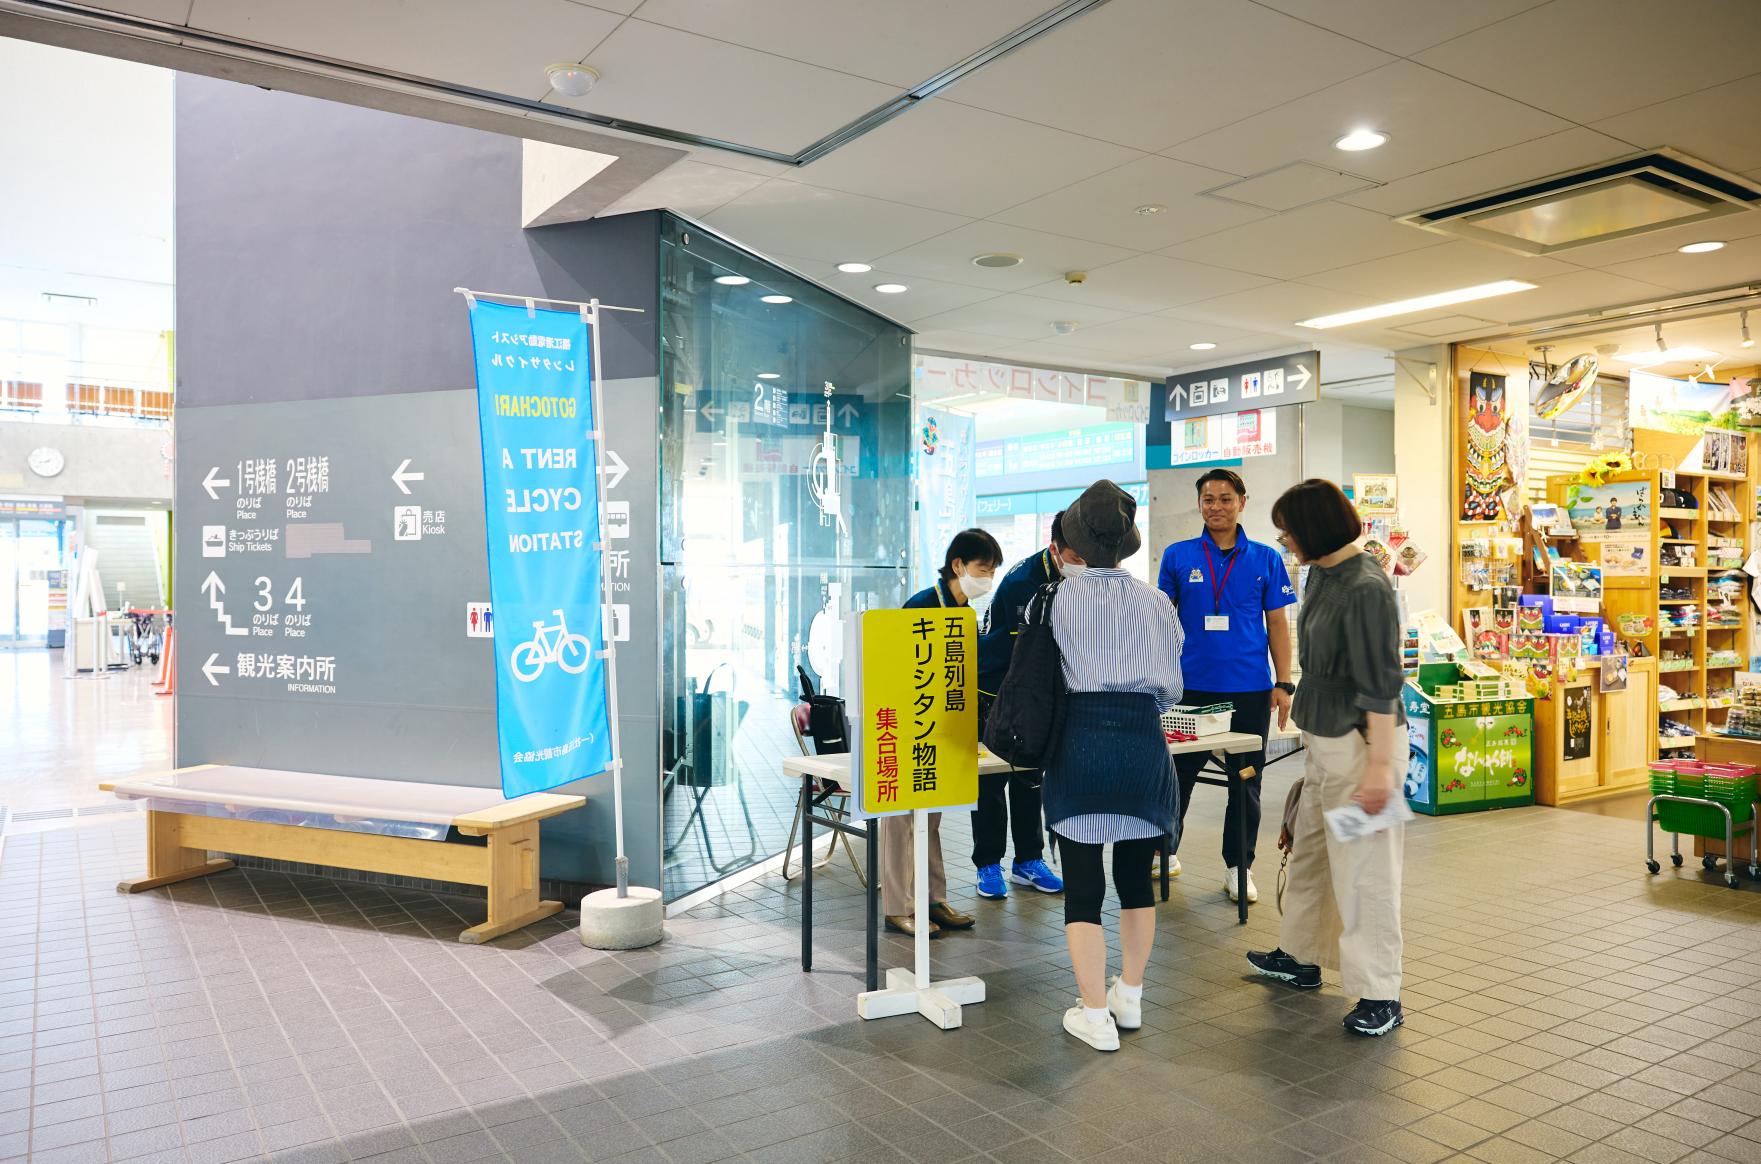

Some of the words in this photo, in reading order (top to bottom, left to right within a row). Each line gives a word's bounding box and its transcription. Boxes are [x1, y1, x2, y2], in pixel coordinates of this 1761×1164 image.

[1173, 450, 1219, 463] コインロッカー
[1223, 442, 1272, 458] 自動販売機
[237, 458, 277, 496] 1号桟橋
[286, 455, 329, 494] 2号桟橋
[236, 497, 262, 509] のりば
[286, 495, 312, 508] のりば
[236, 509, 257, 520] Place
[286, 509, 307, 519] Place
[422, 510, 446, 523] 売店
[228, 528, 280, 542] きっぷうりば
[422, 523, 446, 535] Kiosk
[228, 542, 245, 553] Ship
[246, 541, 273, 552] Tickets
[253, 576, 273, 612] 3
[284, 576, 306, 612] 4
[253, 613, 279, 626] のりば
[284, 614, 311, 627] のりば
[253, 626, 274, 637] Place
[284, 627, 306, 638] Place
[236, 652, 336, 682] 観光案内所
[944, 616, 965, 712] 五島列島
[287, 683, 336, 694] INFORMATION
[912, 617, 937, 793] キリシタン物語
[1443, 699, 1528, 719] 五島市観光協会
[876, 707, 899, 803] 集合場所
